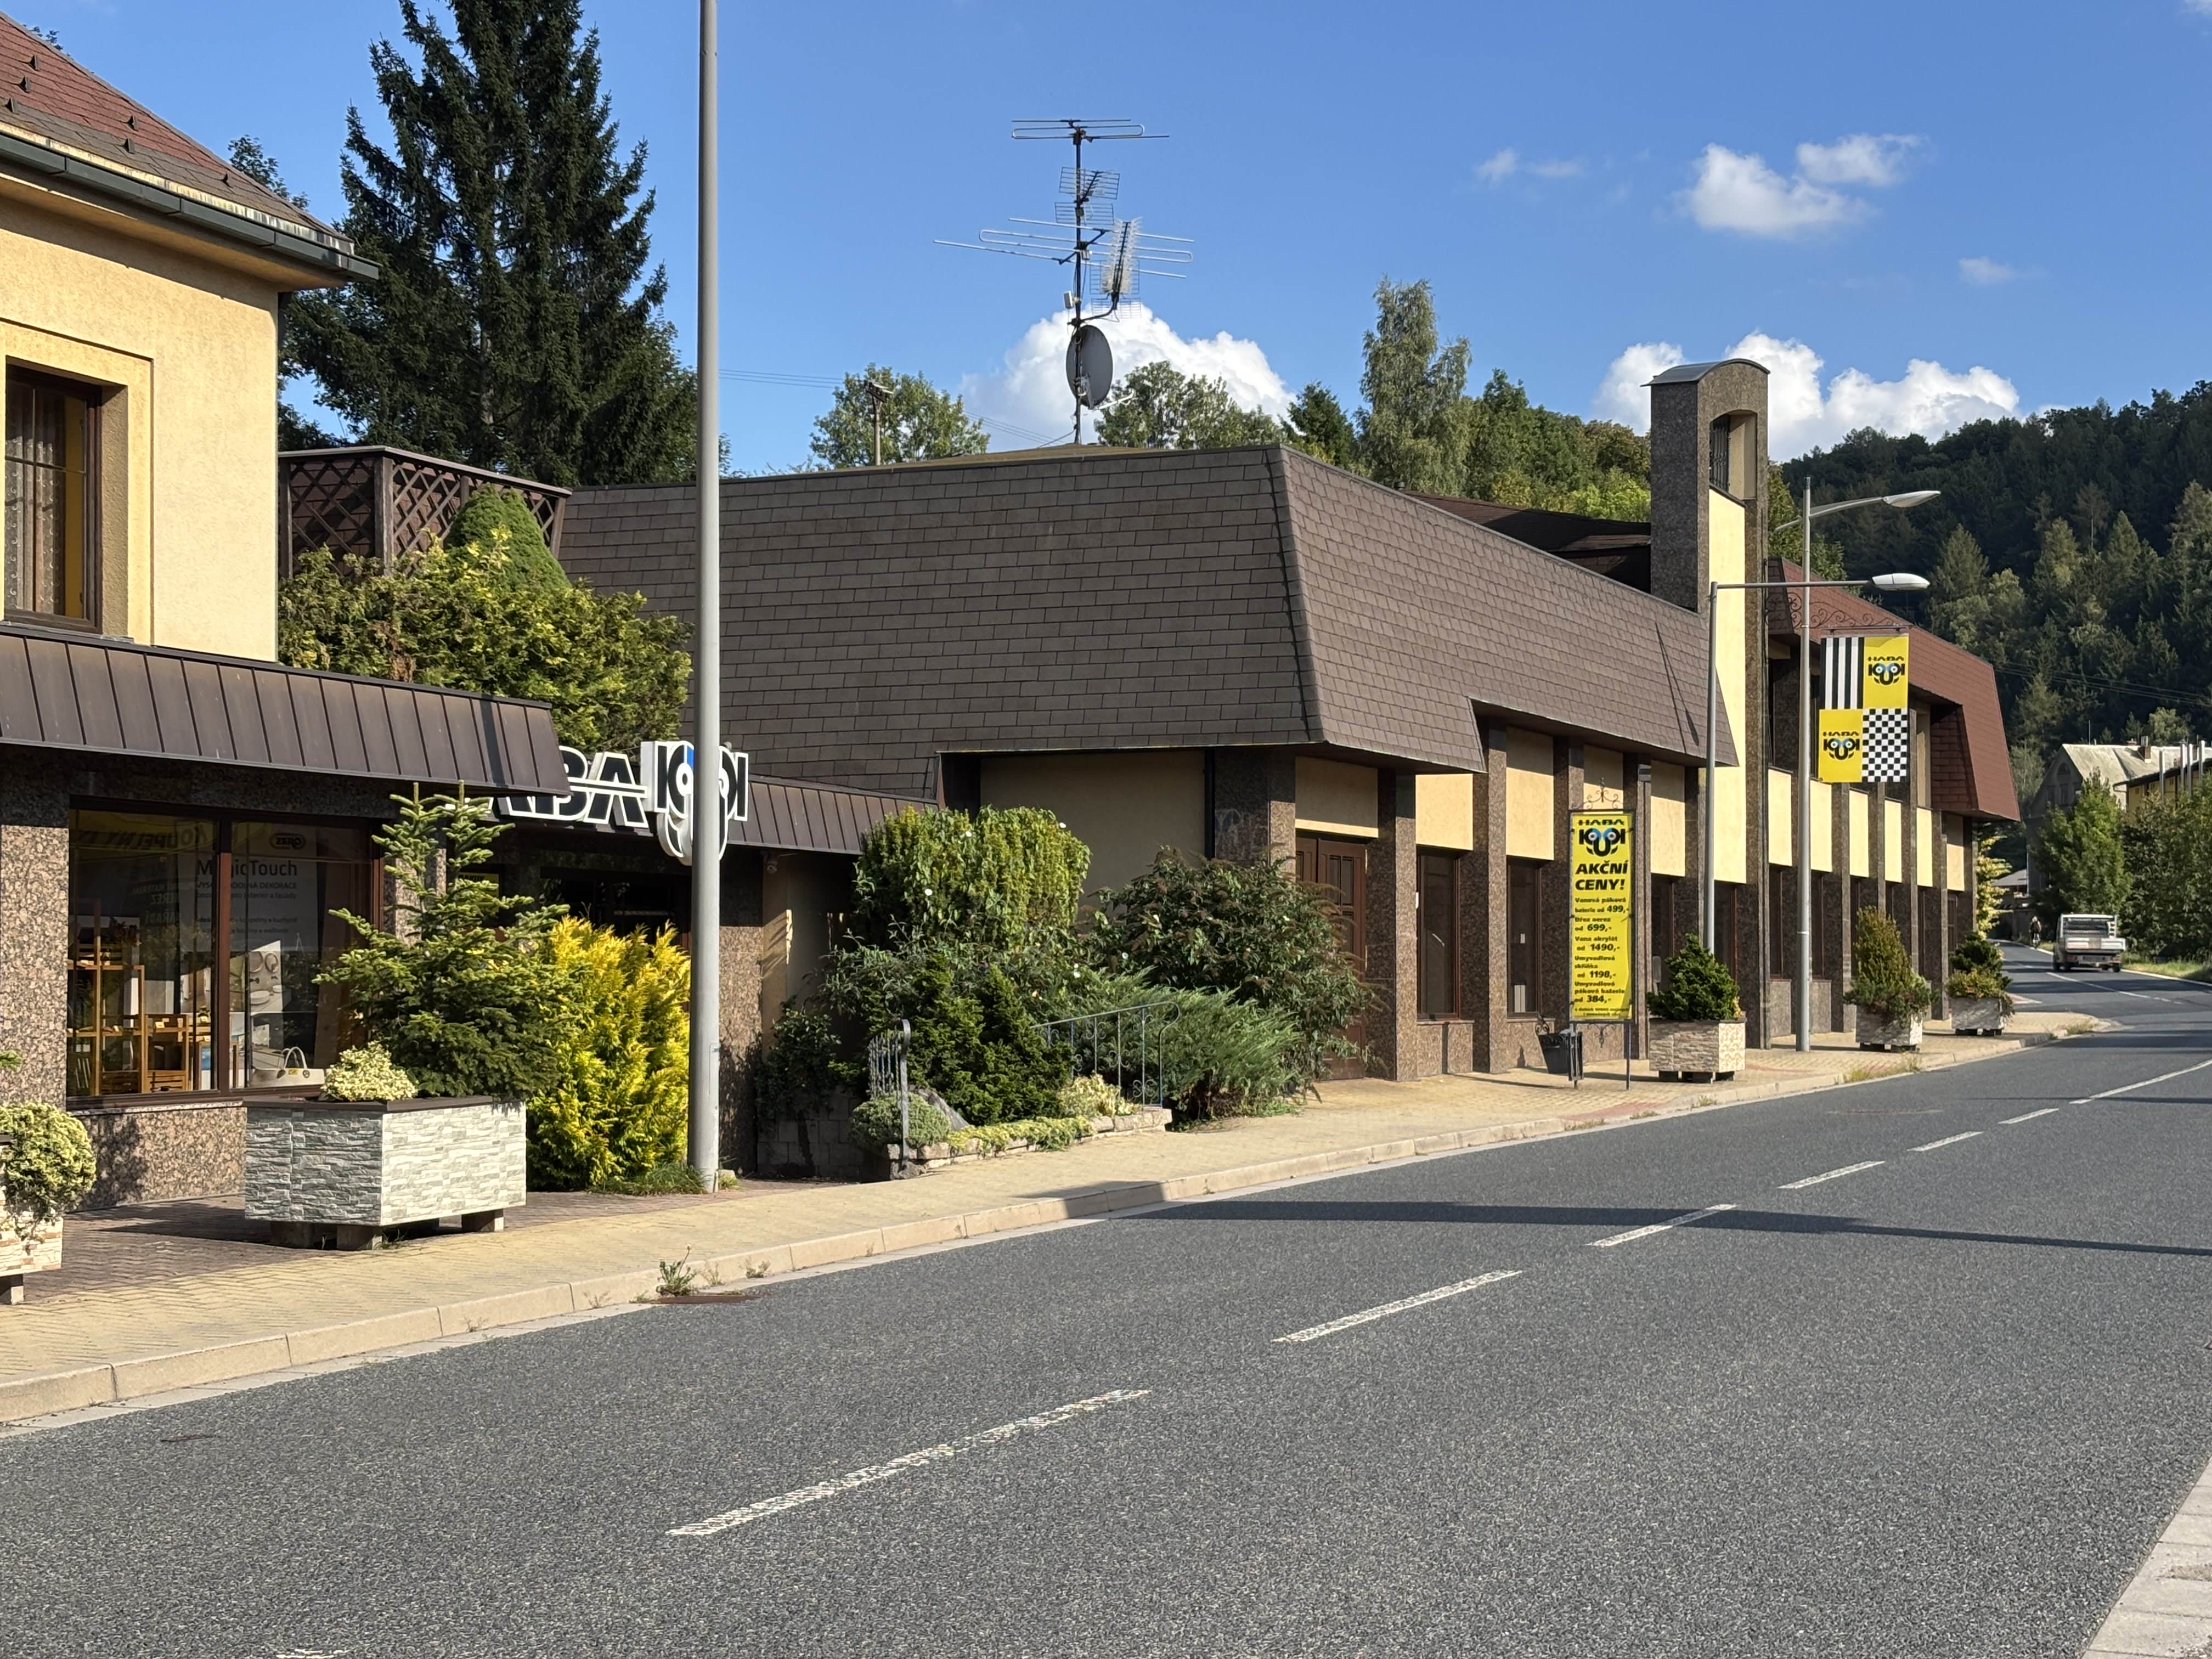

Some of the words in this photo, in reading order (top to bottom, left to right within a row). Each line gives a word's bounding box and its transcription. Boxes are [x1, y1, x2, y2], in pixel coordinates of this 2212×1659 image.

[276, 837, 302, 849] ZERO
[1575, 860, 1629, 875] AKČNÍ
[1575, 879, 1626, 891] CENY!
